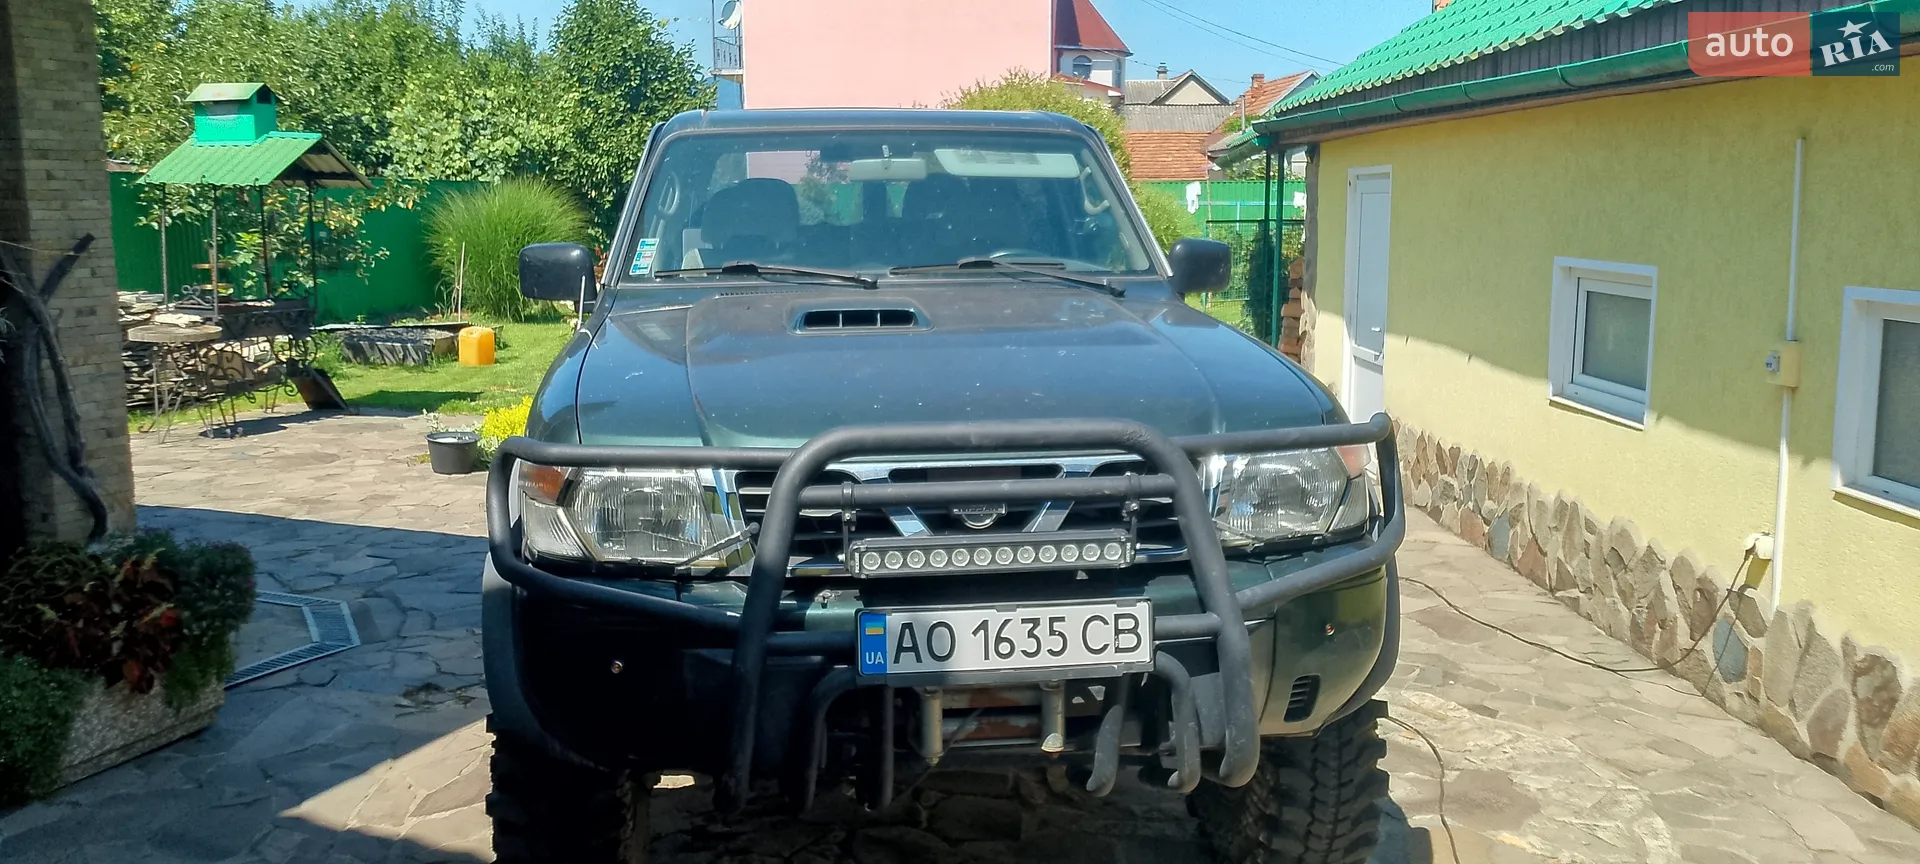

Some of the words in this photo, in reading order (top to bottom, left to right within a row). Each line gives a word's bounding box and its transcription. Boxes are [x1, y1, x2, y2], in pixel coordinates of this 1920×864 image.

[893, 620, 957, 664] AO
[971, 615, 1069, 661] 1635
[1081, 612, 1143, 655] CB
[866, 652, 884, 665] UA
